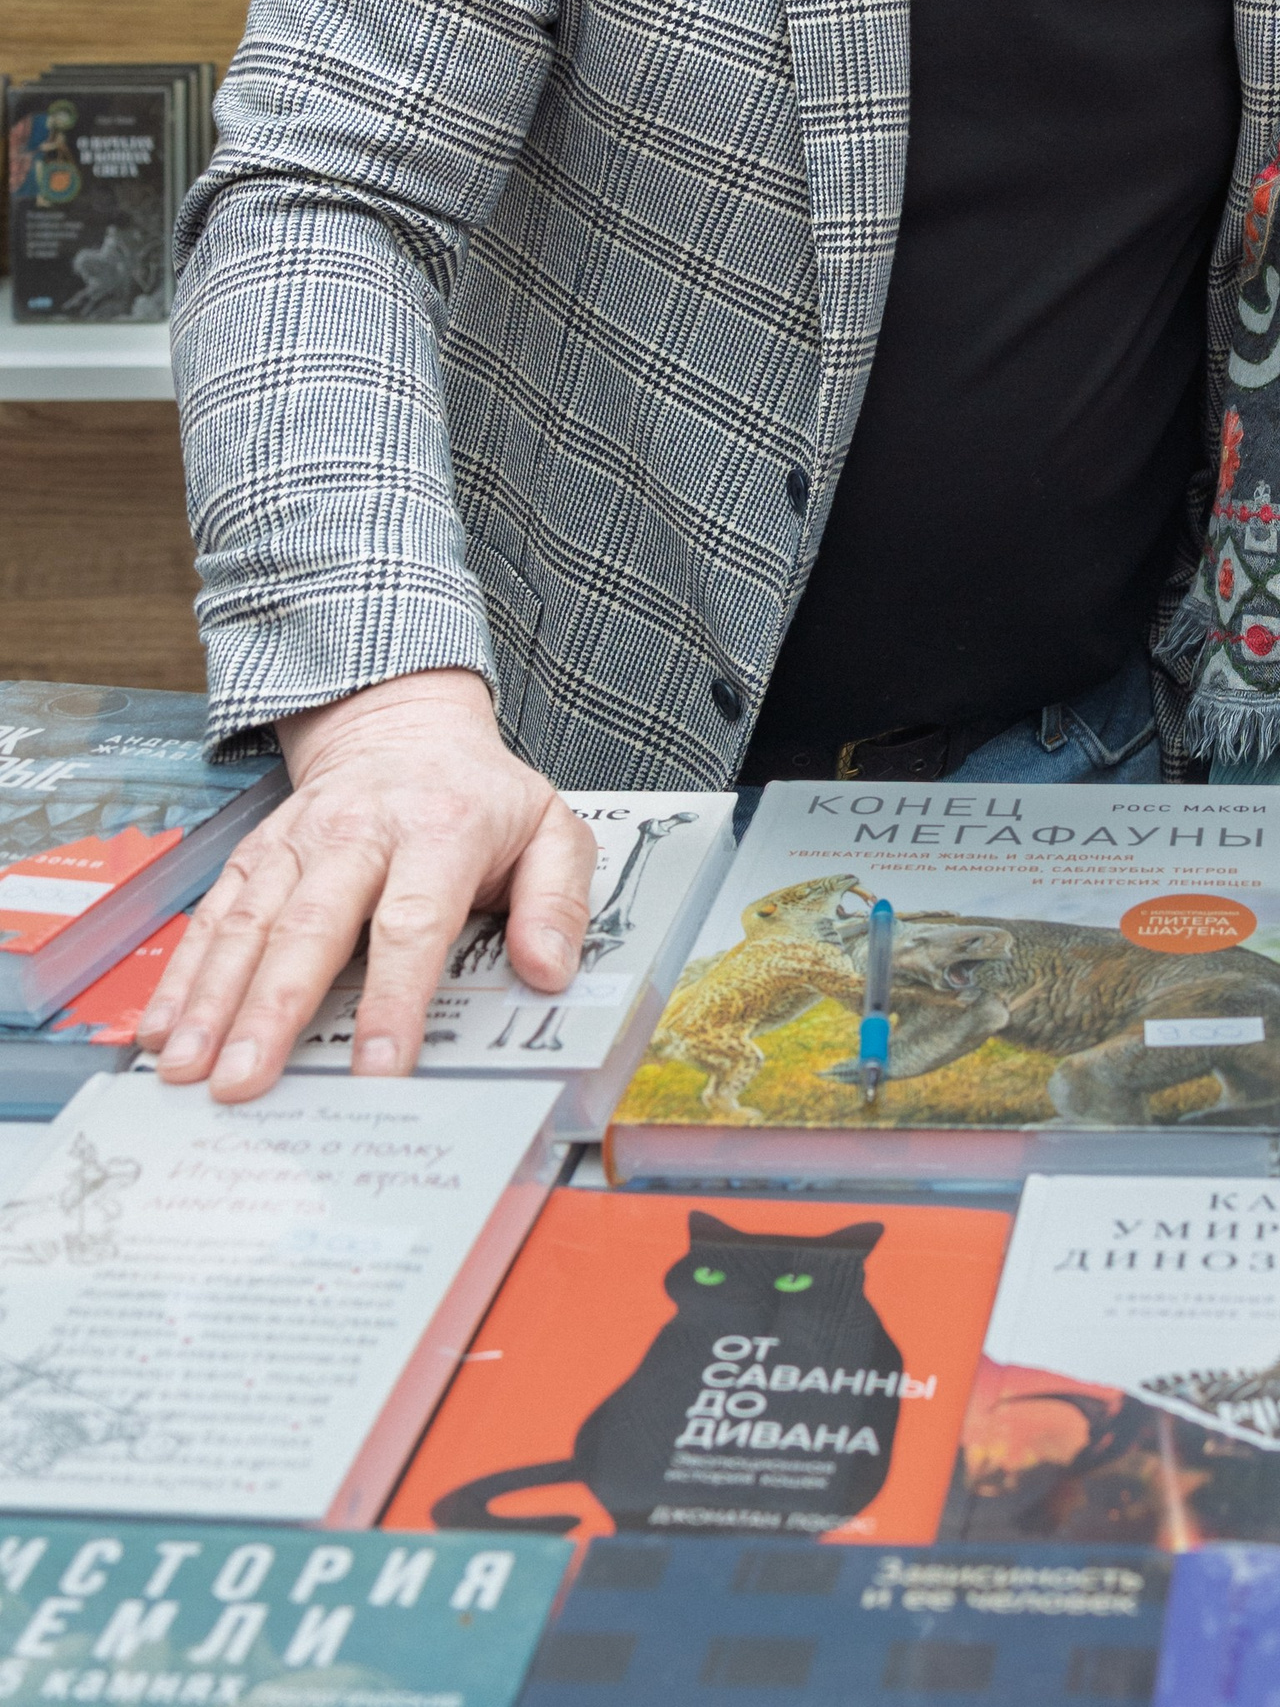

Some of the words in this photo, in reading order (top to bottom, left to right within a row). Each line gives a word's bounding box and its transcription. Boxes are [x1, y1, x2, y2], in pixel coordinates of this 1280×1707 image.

[105, 734, 204, 749] АНДРЕ
[808, 795, 1022, 821] КОНЕЦ
[1113, 804, 1171, 812] РОСС
[1184, 804, 1266, 813] МАКФИ
[854, 823, 1263, 847] МЕГАФАУНЫ
[788, 850, 931, 859] УВЛЕКАТЕЛЬНАЯ
[938, 852, 999, 860] ЖИЗНЬ
[1025, 854, 1134, 862] ЗАГАДОЧНАЯ
[871, 863, 937, 871] ГИБЕЛЬ
[945, 864, 1044, 873] МАМОНТОВ,
[1052, 866, 1165, 874] САБЛЕЗУБЫХ
[1173, 867, 1239, 875] ТИГРОВ
[1051, 878, 1161, 886] ГИГАНТСКИХ
[1168, 879, 1263, 888] ЛЕНИВЦЕВ
[1149, 916, 1230, 926] ПИТЕРА
[1138, 926, 1238, 939] ШАУТЕНА
[712, 1335, 780, 1362] ОТ
[701, 1361, 938, 1401] САВАННЫ
[684, 1390, 767, 1421] ДО
[674, 1418, 881, 1457] ДИВАНА
